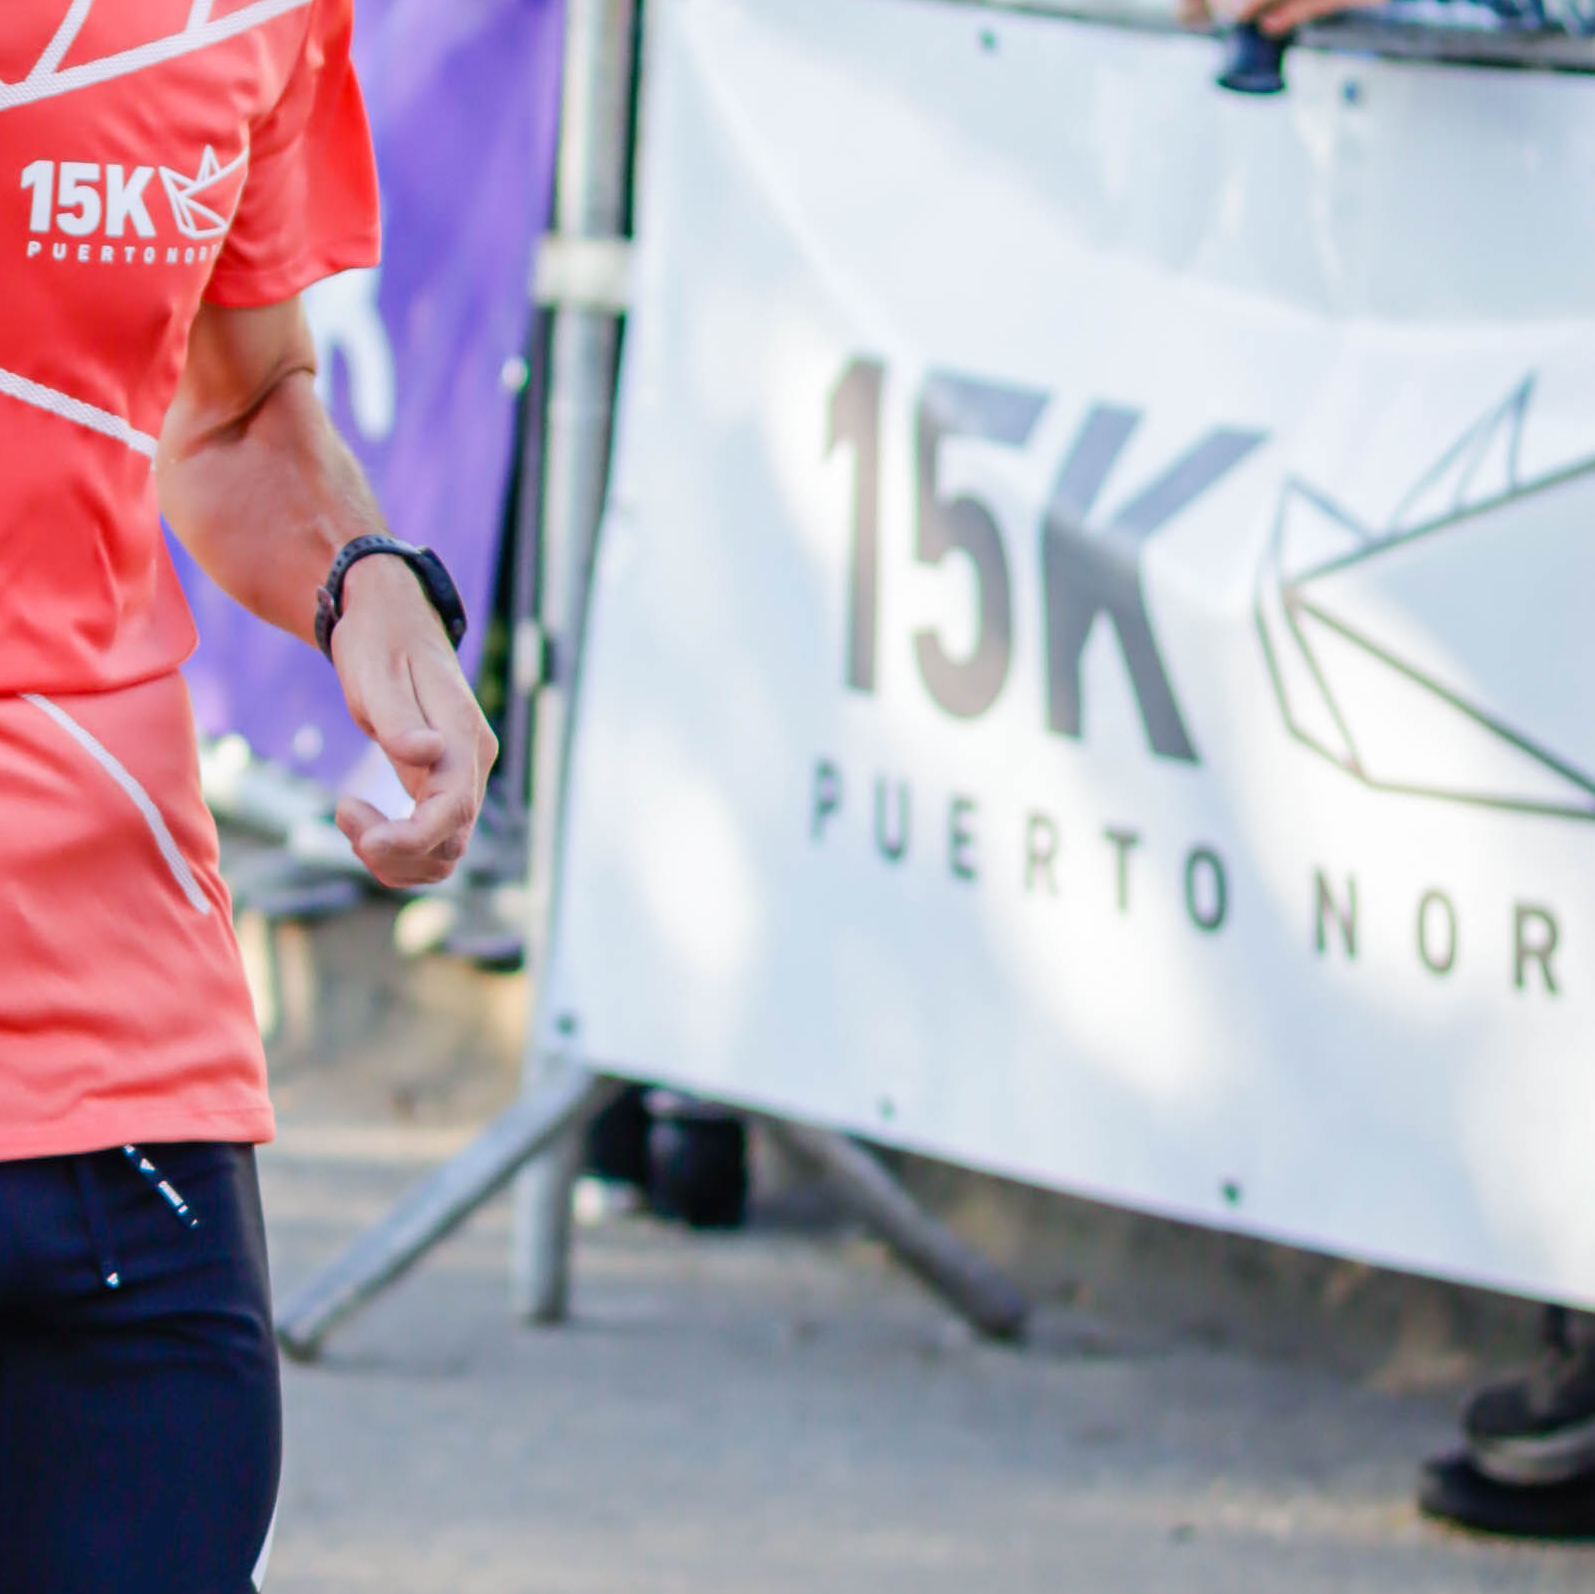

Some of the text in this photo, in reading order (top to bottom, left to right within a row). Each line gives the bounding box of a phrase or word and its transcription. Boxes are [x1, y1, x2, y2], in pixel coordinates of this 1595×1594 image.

[21, 160, 157, 237] 15K
[26, 241, 155, 264] PUERTO
[825, 353, 1270, 767] 15K
[813, 759, 1562, 993] PUERTO NOR
